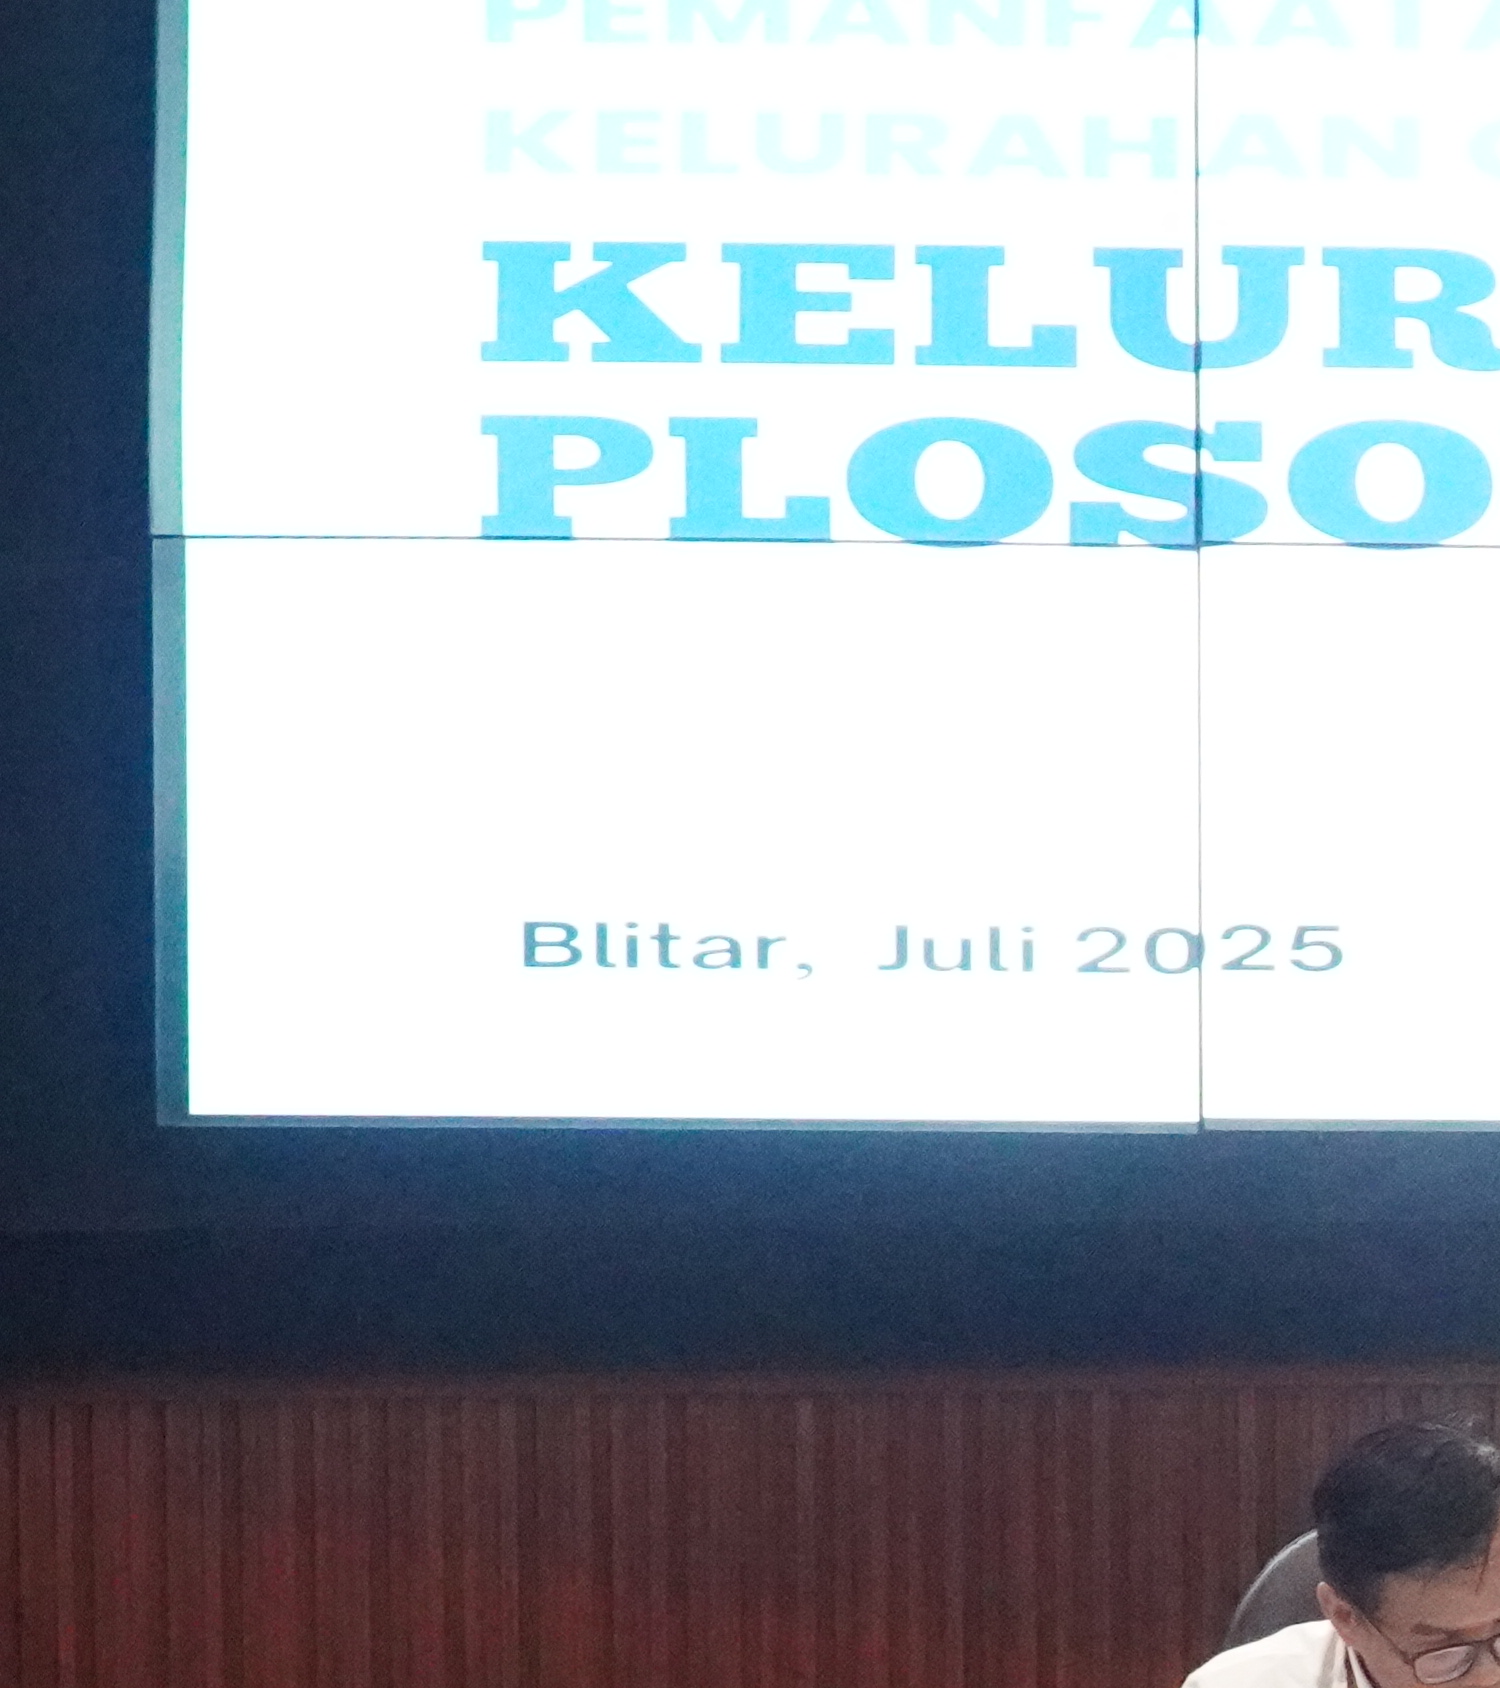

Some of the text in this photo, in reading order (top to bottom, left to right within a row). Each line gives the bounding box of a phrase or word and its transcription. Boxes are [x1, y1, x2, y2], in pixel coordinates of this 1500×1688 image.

[480, 106, 1420, 182] KELURAHAN
[522, 920, 1344, 980] Blitar, Juli 2025
